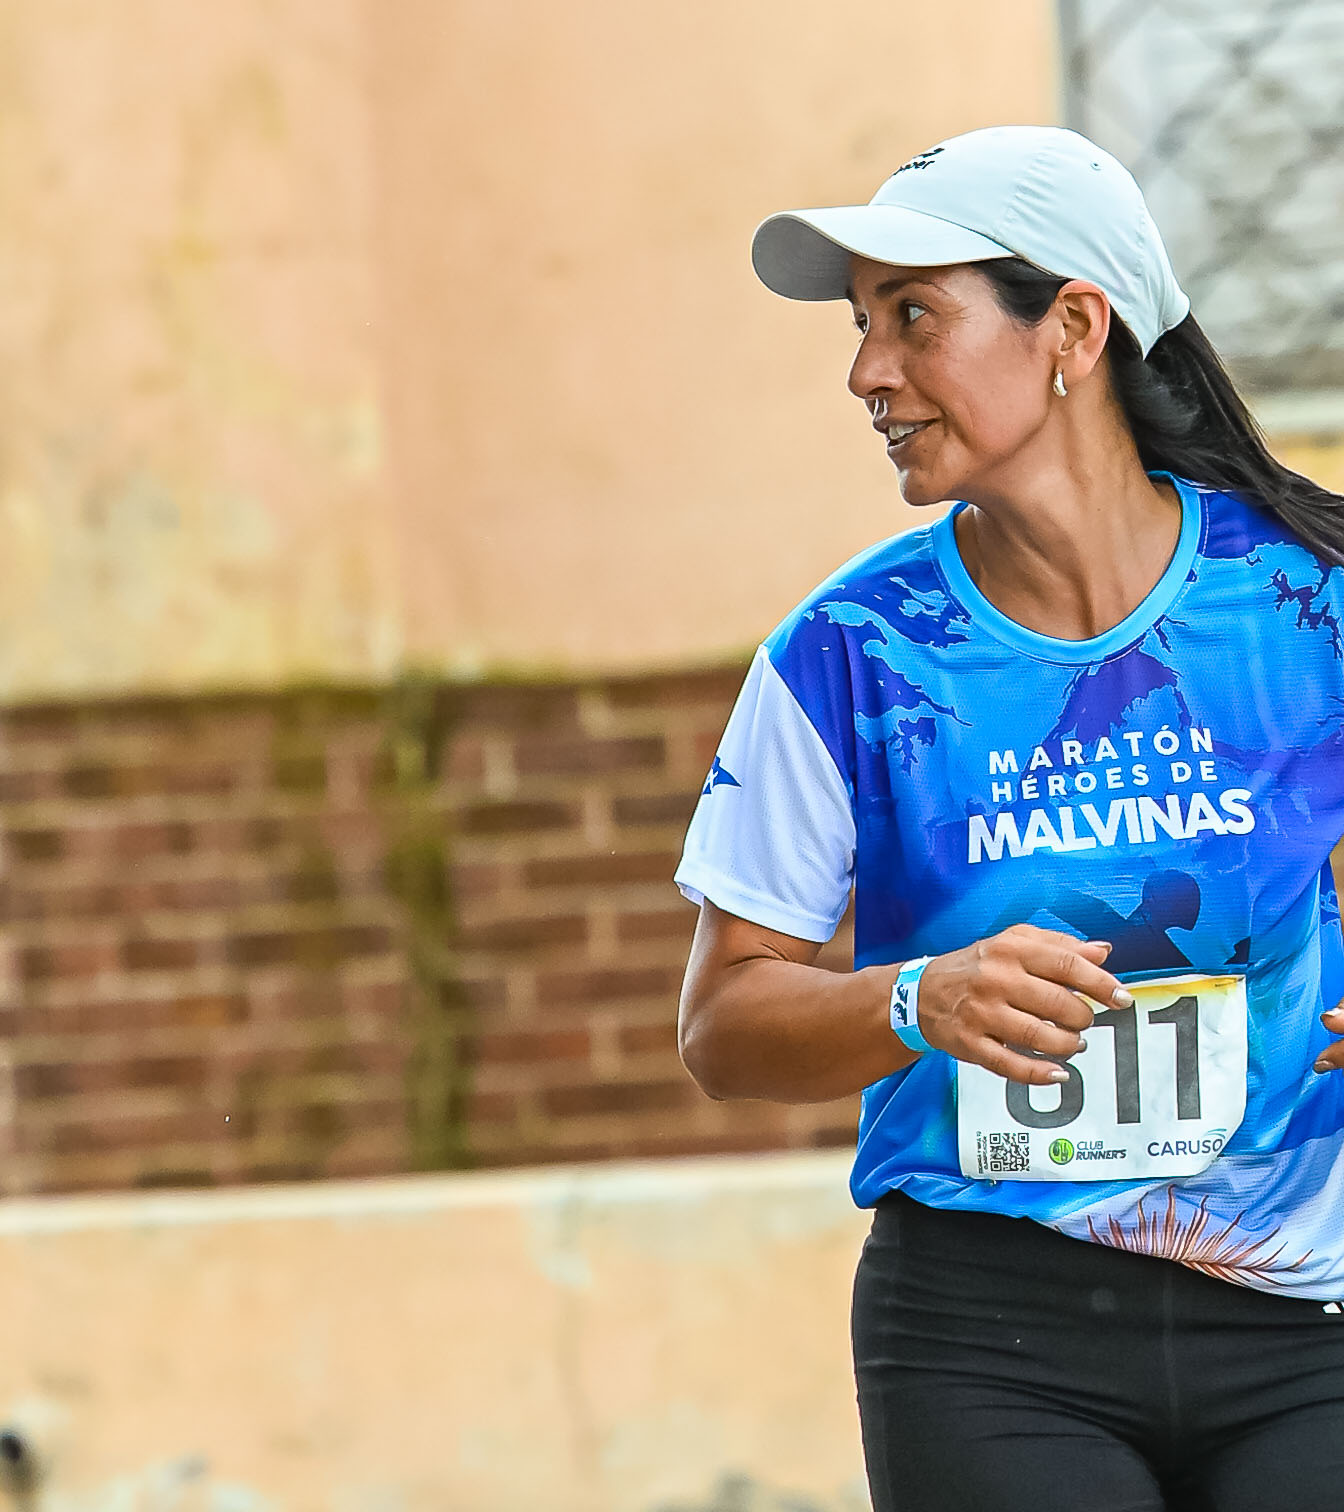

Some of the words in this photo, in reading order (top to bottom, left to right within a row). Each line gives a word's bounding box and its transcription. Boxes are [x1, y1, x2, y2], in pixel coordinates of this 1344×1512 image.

[989, 725, 1214, 775] MARATÓN
[992, 761, 1150, 803] HÉROES
[1171, 760, 1218, 784] DE
[967, 788, 1256, 864] MALVINAS
[1076, 1140, 1103, 1150] CLUB
[1147, 1139, 1223, 1156] CARUSO
